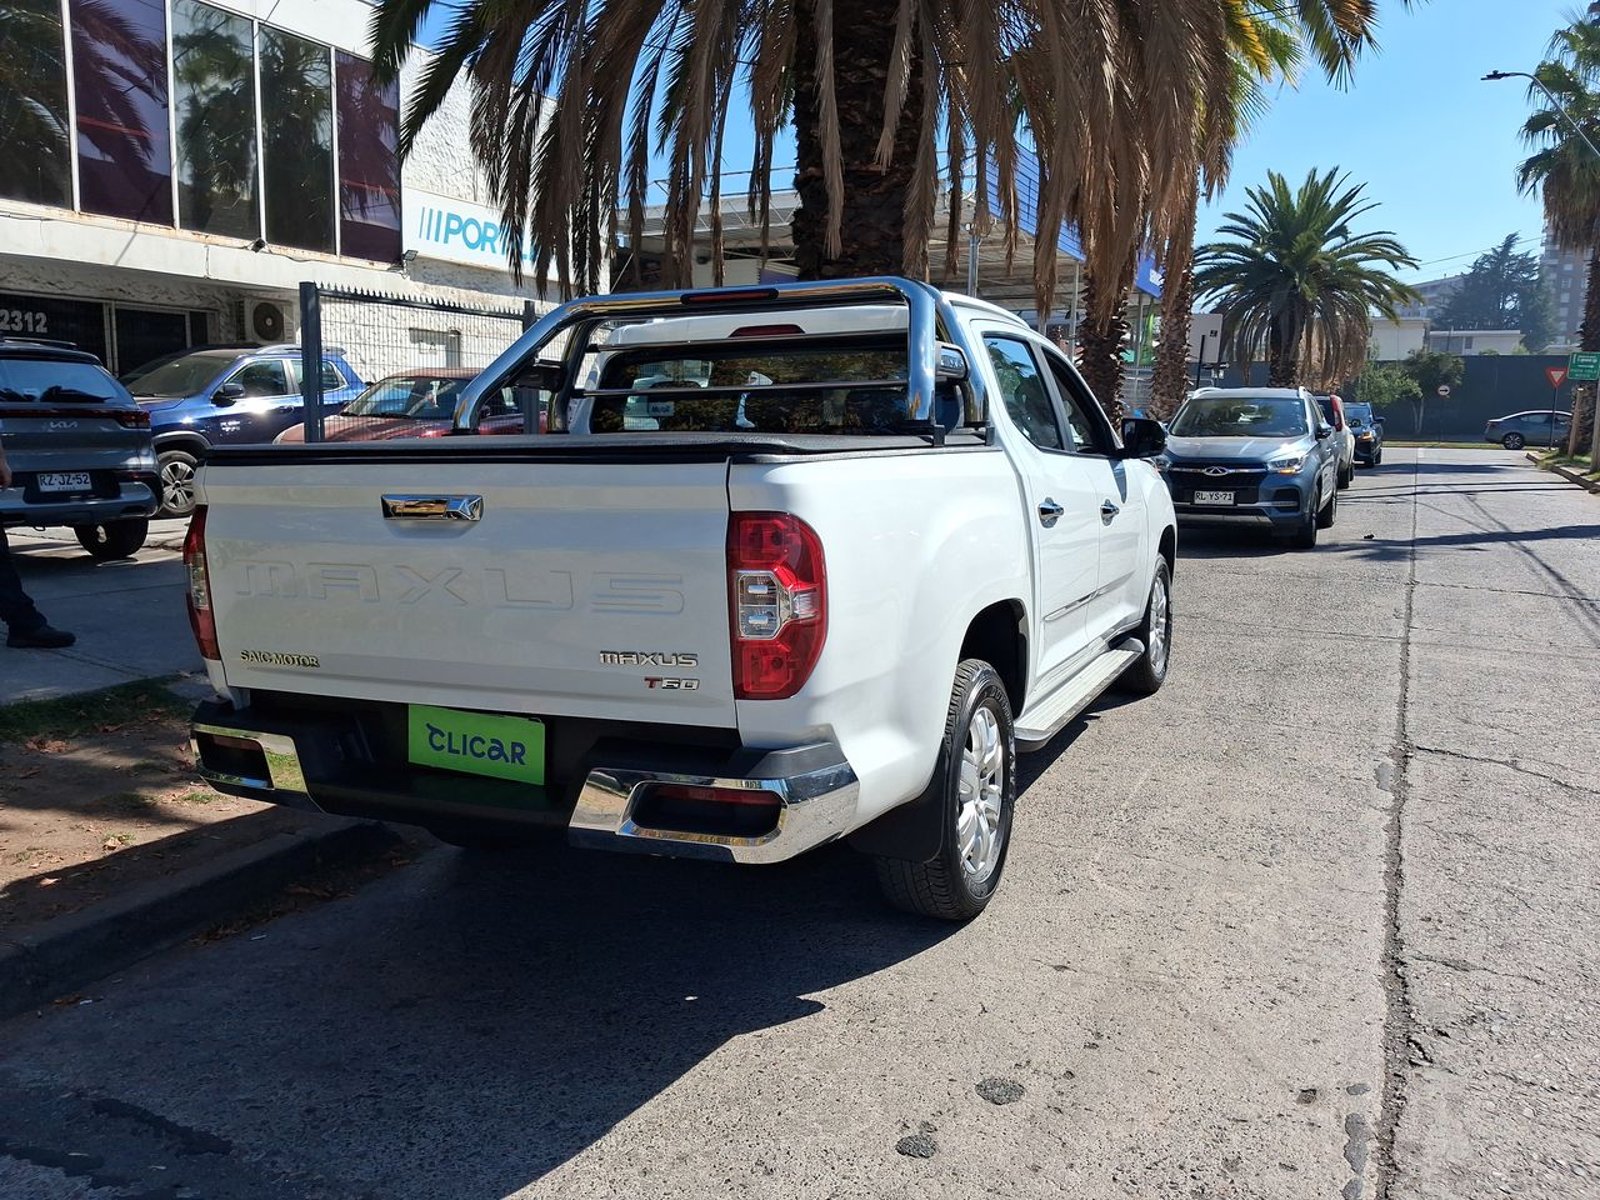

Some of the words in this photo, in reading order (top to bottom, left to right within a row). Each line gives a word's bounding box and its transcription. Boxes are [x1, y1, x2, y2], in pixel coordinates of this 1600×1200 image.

[0, 309, 48, 333] 2312
[235, 559, 685, 616] MAXUS
[599, 650, 698, 668] MAXUS
[644, 676, 700, 690] T60
